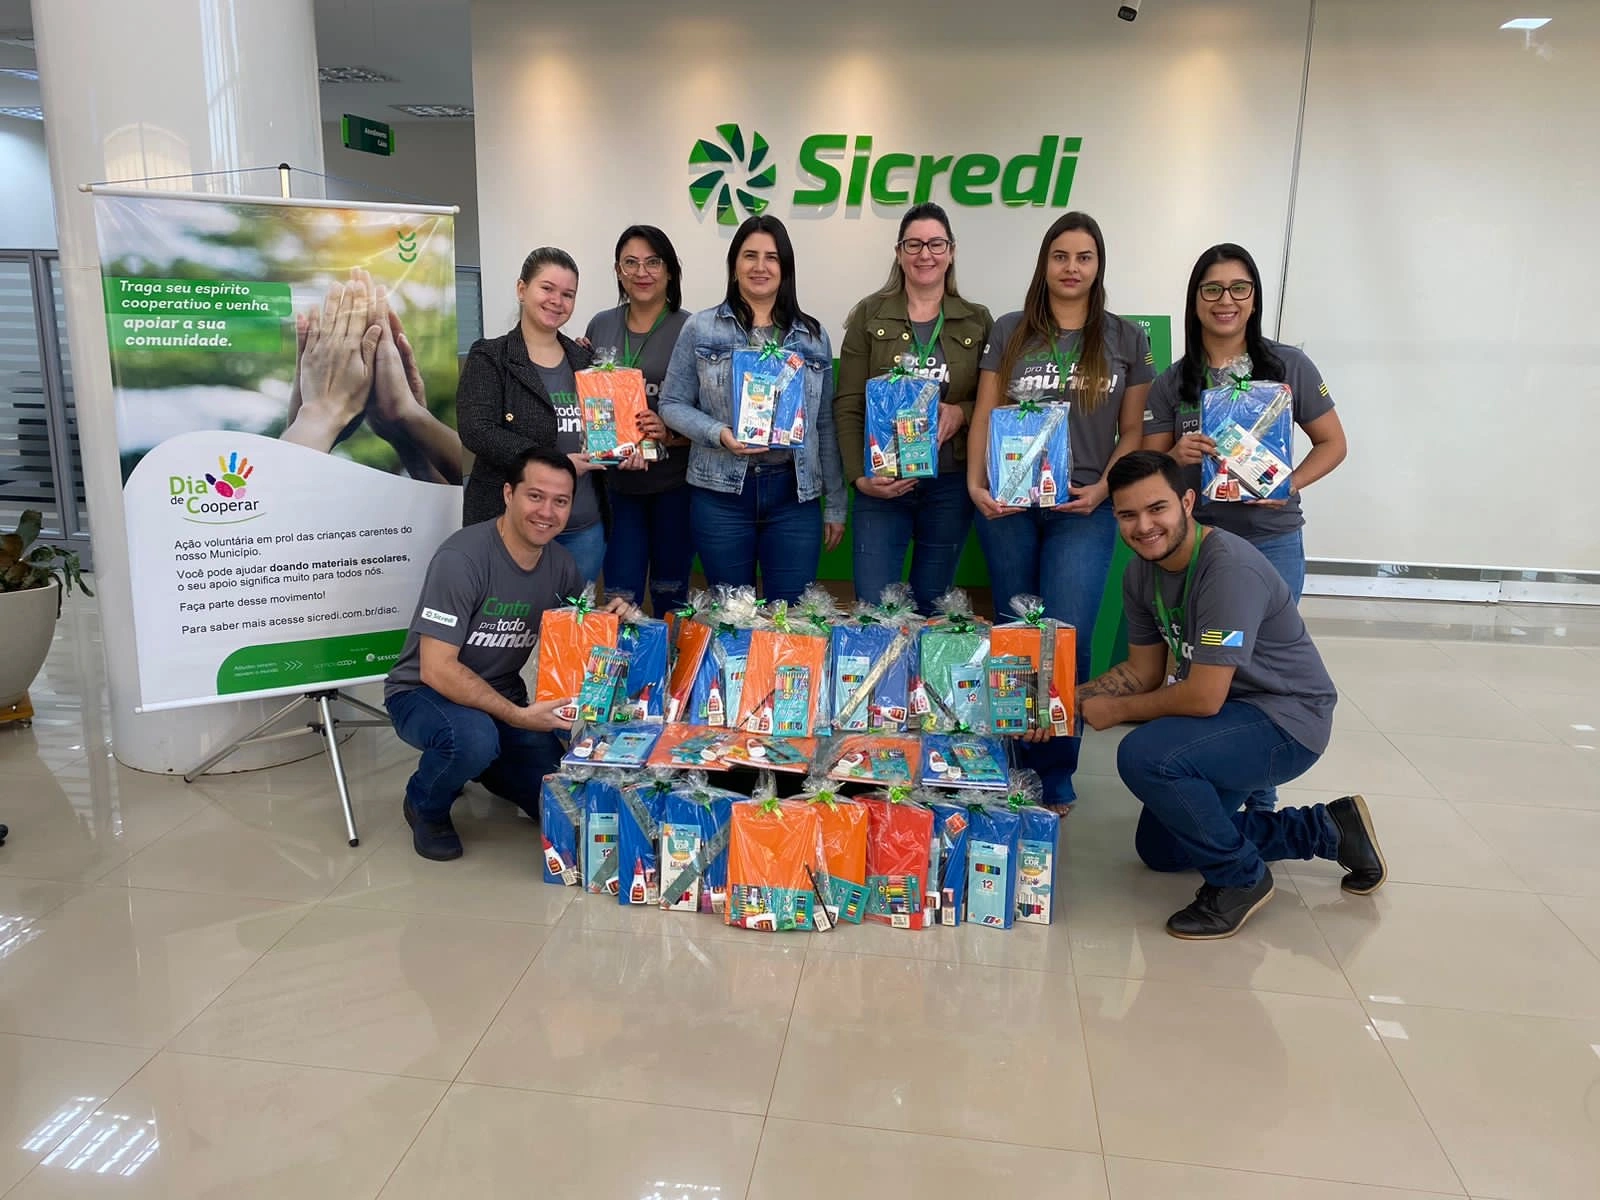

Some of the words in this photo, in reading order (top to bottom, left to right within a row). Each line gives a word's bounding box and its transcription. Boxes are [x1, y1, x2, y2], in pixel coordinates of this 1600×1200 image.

[793, 134, 1083, 207] Sicredi
[120, 280, 162, 296] Traga
[166, 284, 191, 293] seu
[195, 283, 250, 297] espírito
[121, 298, 211, 312] cooperativo
[215, 302, 223, 310] e
[226, 300, 269, 311] venha
[124, 316, 180, 332] apoiar
[183, 319, 193, 329] a
[197, 319, 226, 330] sua
[125, 333, 232, 347] comunidade.
[169, 476, 208, 495] Dia
[170, 496, 184, 505] de
[186, 496, 260, 515] Cooperar
[174, 539, 202, 551] Ação
[204, 535, 254, 548] voluntária
[256, 536, 273, 544] em
[275, 533, 294, 544] prol
[296, 532, 314, 541] das
[316, 530, 357, 540] crianças
[359, 527, 399, 537] carentes
[400, 525, 413, 534] do
[175, 552, 207, 561] nosso
[209, 547, 262, 559] Município.
[176, 569, 204, 579] Você
[207, 567, 232, 579] pode
[235, 564, 267, 577] ajudar
[269, 562, 309, 572] doando
[312, 557, 358, 569] materiais
[360, 553, 411, 565] escolares,
[177, 584, 185, 592] o
[187, 582, 206, 591] seu
[209, 579, 238, 590] apoio
[240, 575, 280, 587] significa
[283, 573, 310, 582] muito
[312, 572, 334, 582] para
[336, 569, 362, 578] todos
[364, 567, 385, 576] nós.
[179, 602, 206, 613] Faça
[208, 599, 235, 611] parte
[237, 597, 268, 607] desse
[270, 590, 326, 604] movimento!
[181, 625, 207, 635] Para
[209, 622, 239, 632] saber
[242, 619, 267, 629] mais
[269, 617, 305, 626] acesse
[496, 618, 525, 632] todo
[466, 629, 539, 649] mundo
[981, 879, 993, 889] 12
